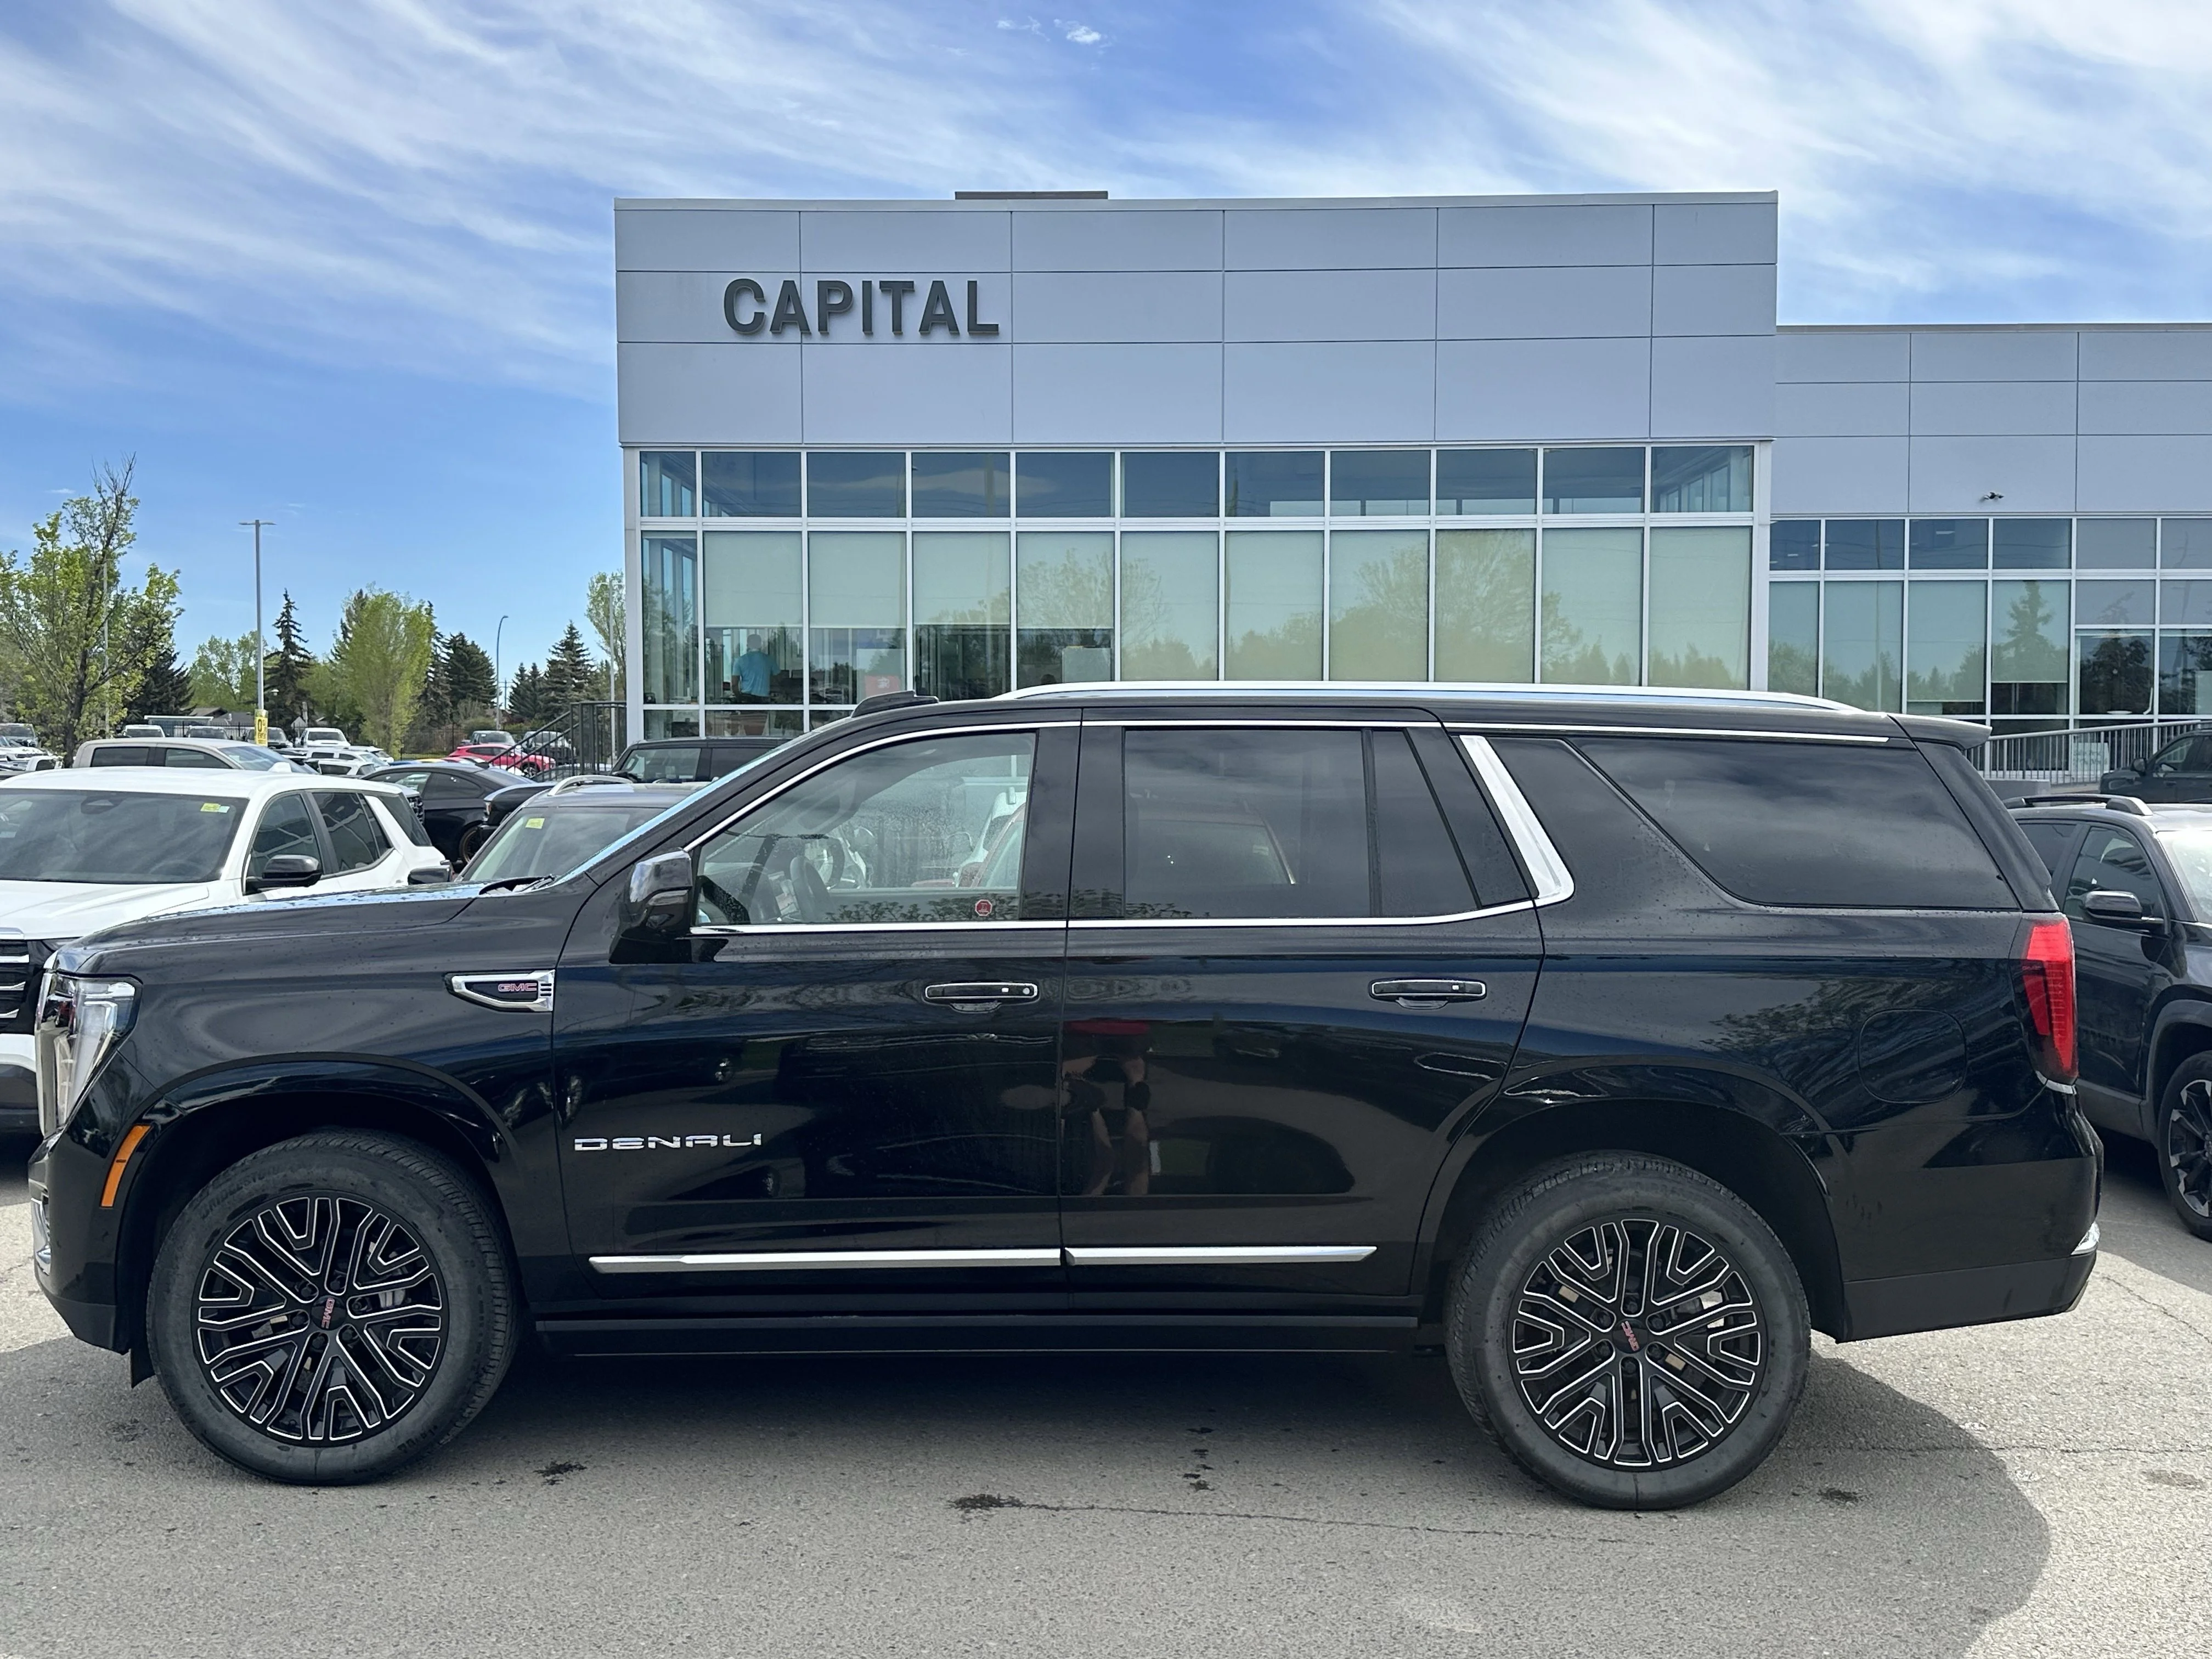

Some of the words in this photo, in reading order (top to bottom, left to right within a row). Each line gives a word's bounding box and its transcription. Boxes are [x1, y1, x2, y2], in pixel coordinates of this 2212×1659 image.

[724, 278, 999, 335] CAPITAL
[498, 983, 537, 992] GMC
[574, 1133, 762, 1151] DENALI
[321, 1297, 335, 1329] GMC
[1621, 1321, 1640, 1351] GMC
